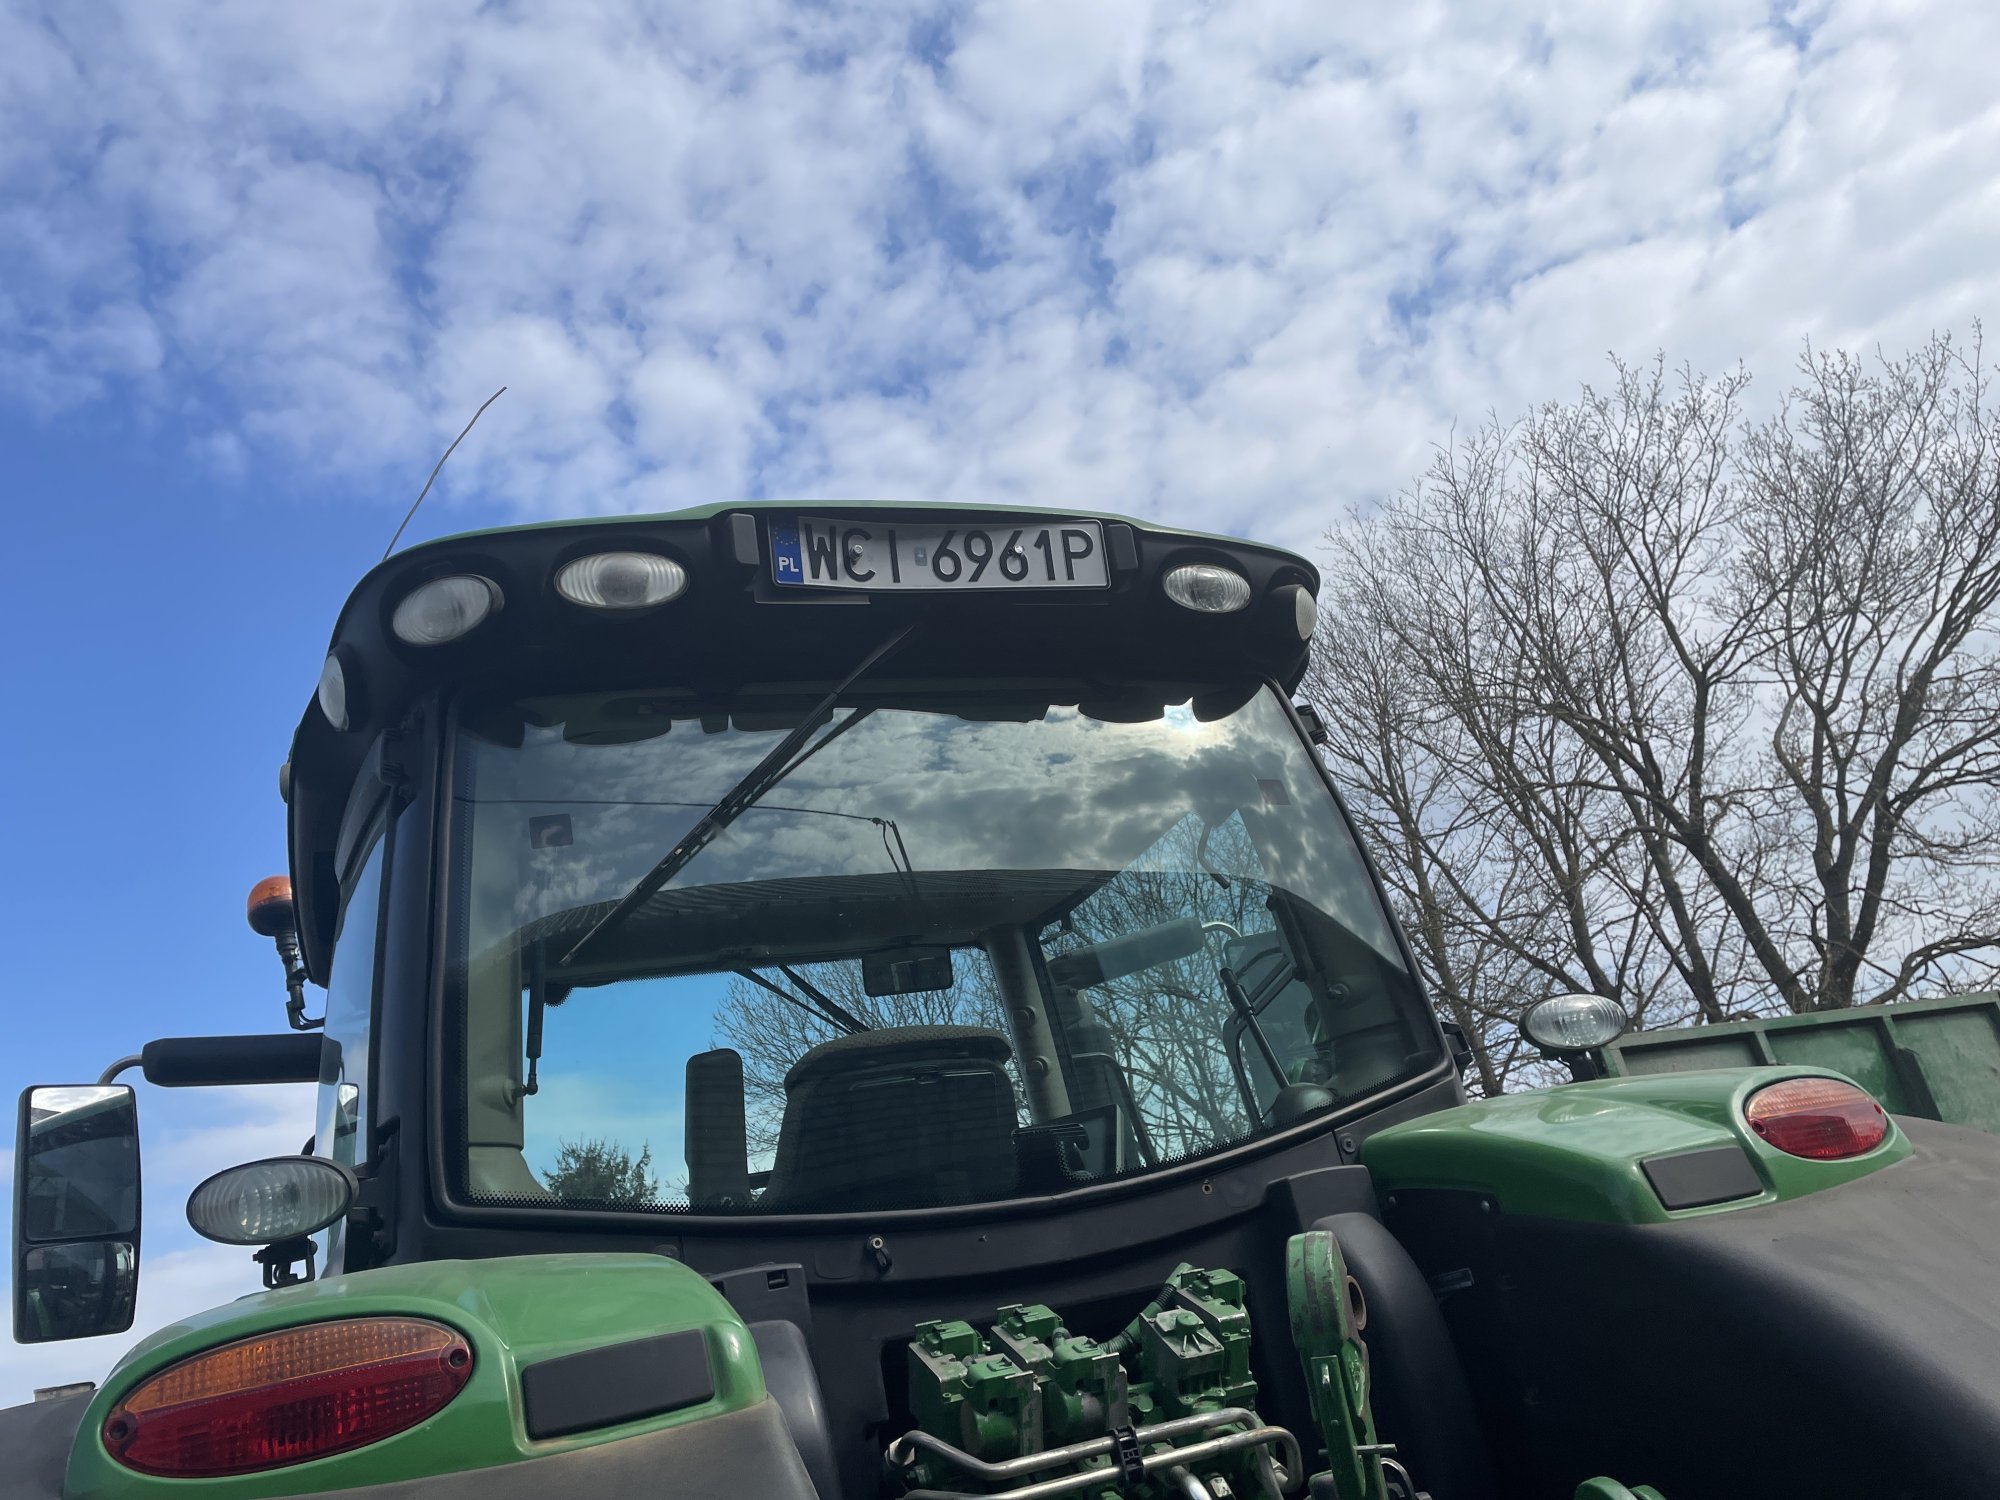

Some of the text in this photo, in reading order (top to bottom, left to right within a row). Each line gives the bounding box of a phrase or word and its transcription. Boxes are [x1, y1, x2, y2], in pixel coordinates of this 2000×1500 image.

[778, 557, 800, 573] PL
[804, 523, 1094, 583] WCI 6961P
